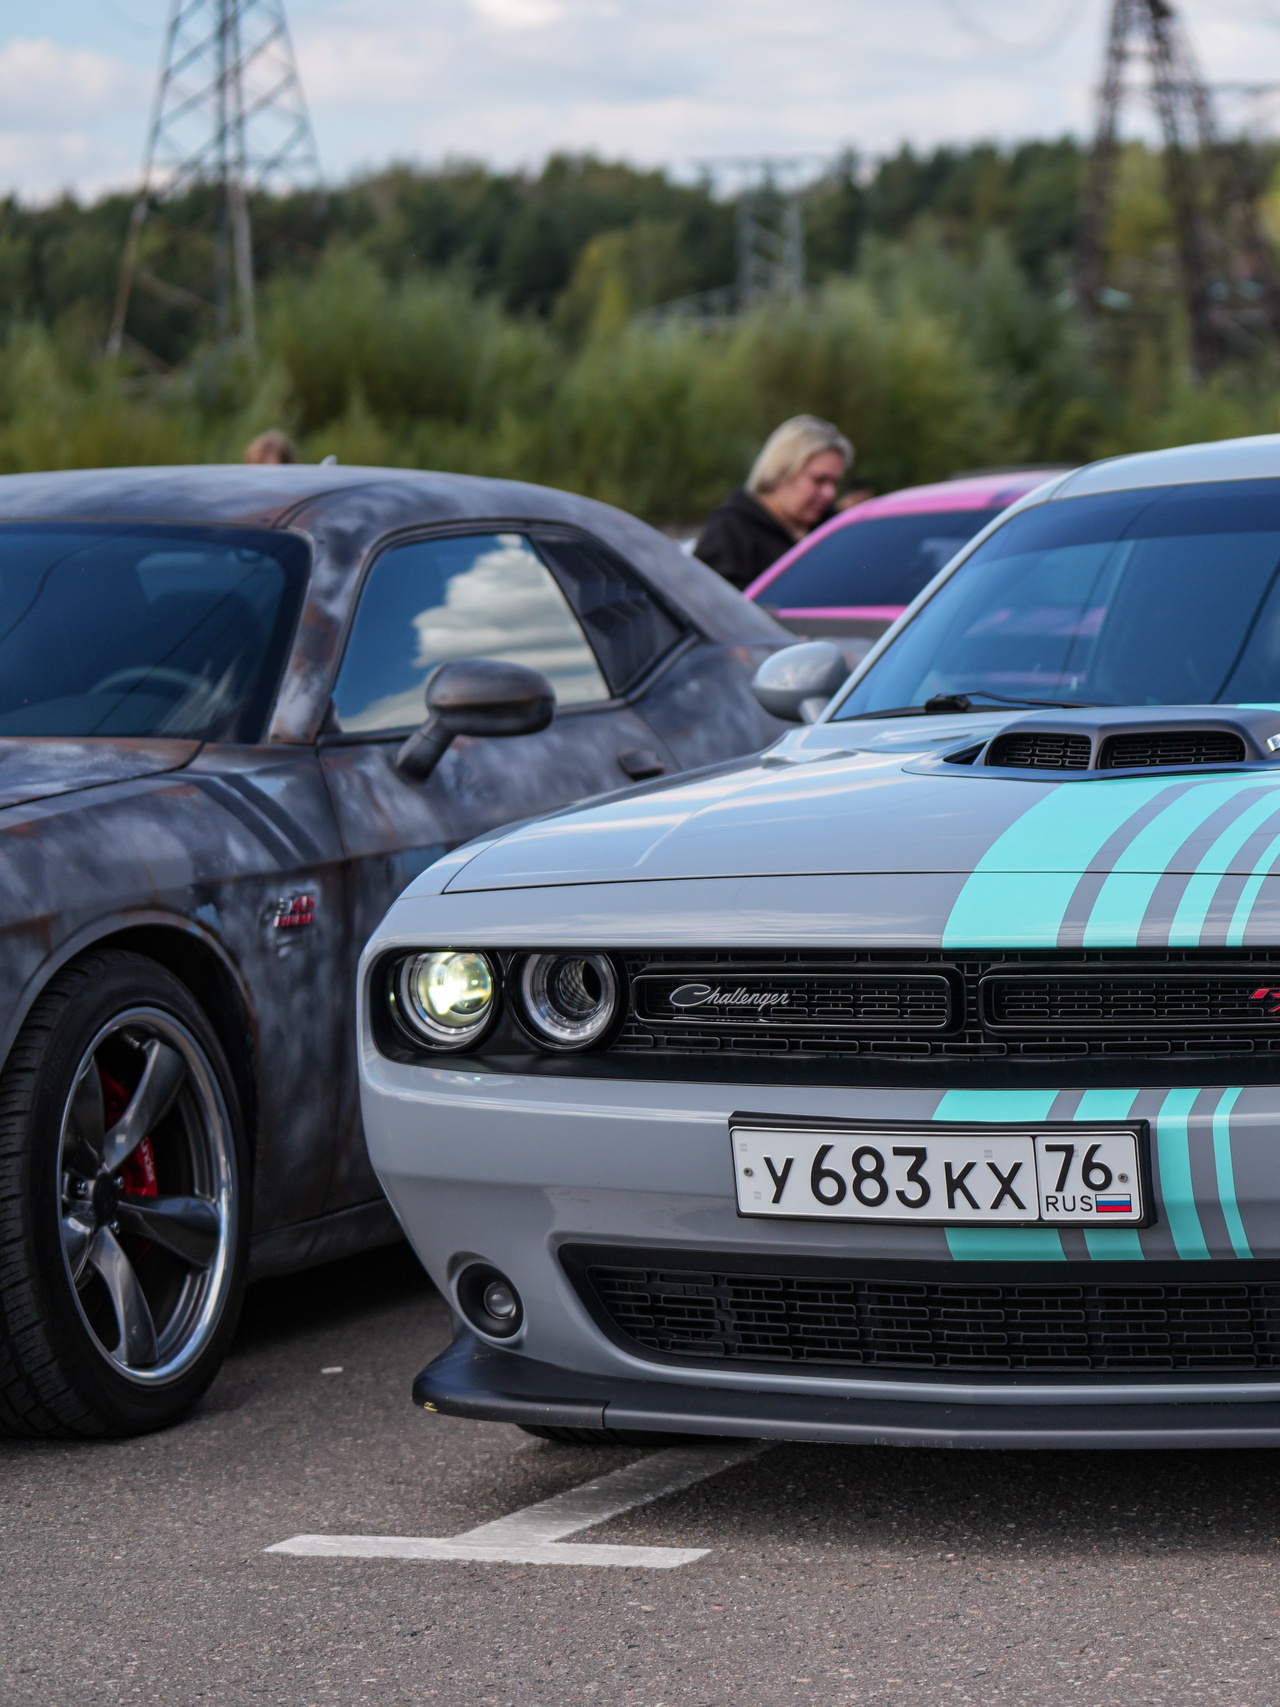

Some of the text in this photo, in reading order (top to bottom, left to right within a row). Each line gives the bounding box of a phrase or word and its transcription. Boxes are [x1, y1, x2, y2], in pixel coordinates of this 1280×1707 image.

[669, 983, 790, 1012] Challenger
[1044, 1143, 1113, 1192] 76
[1046, 1195, 1093, 1213] RUS
